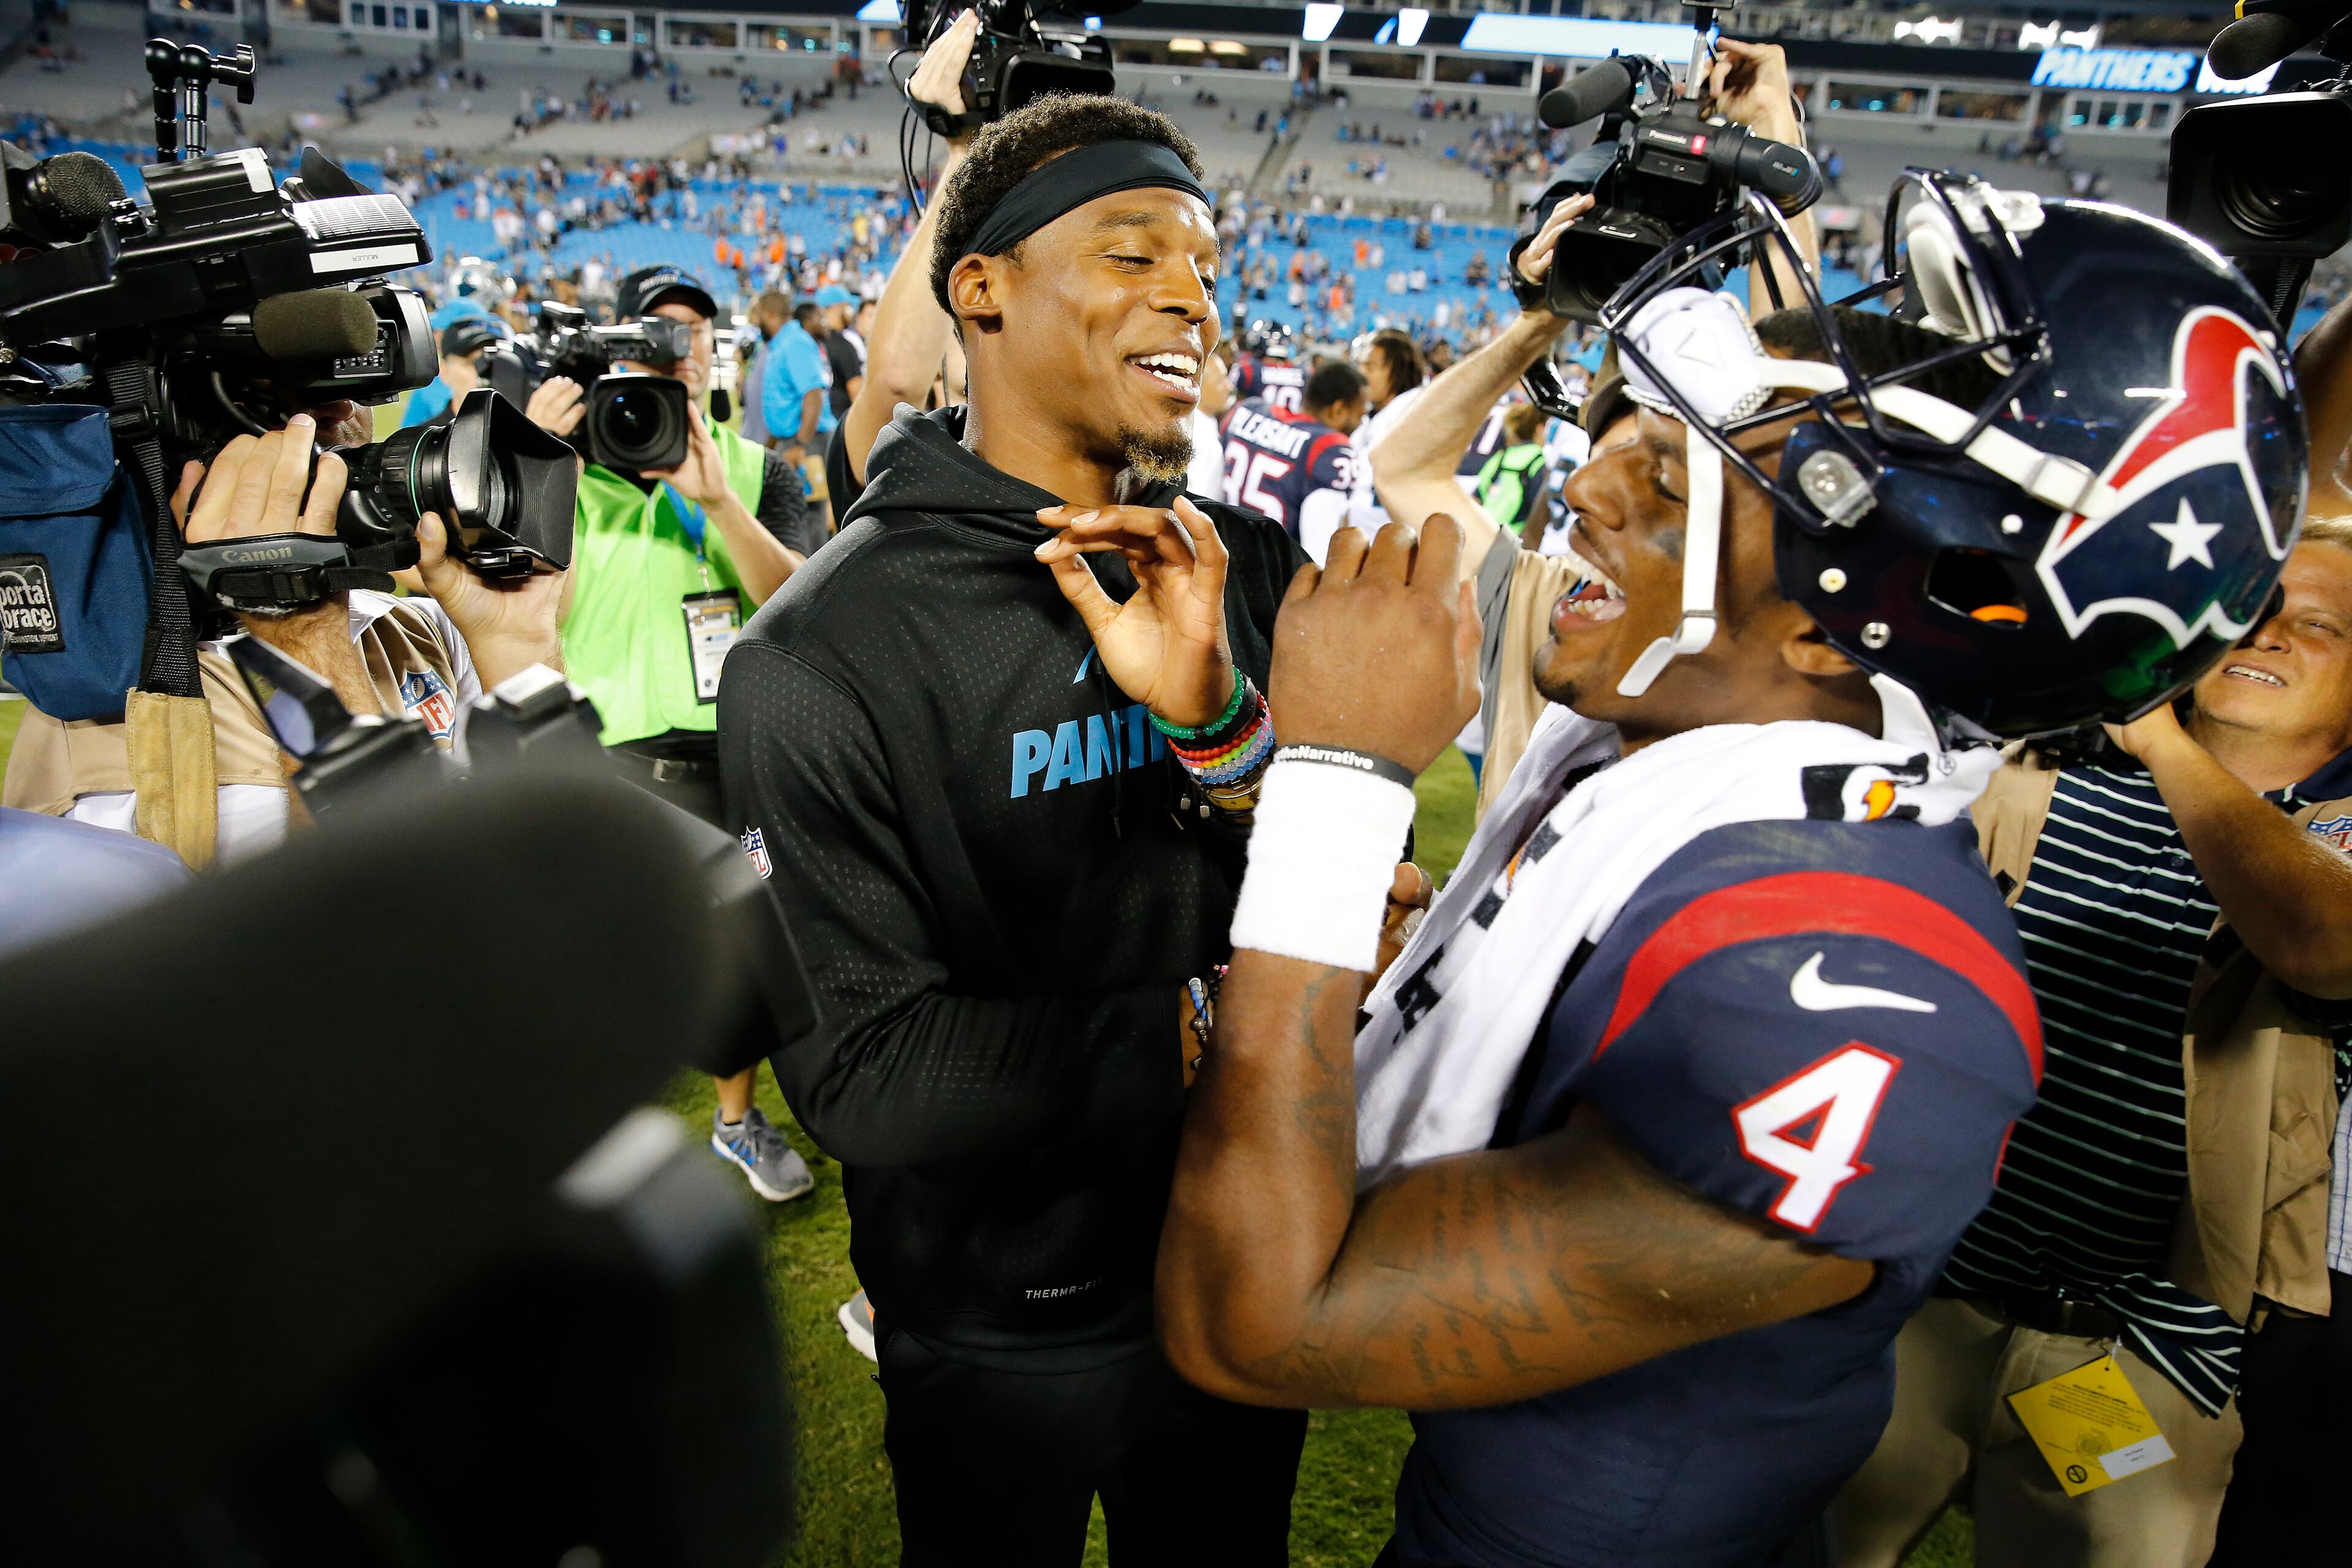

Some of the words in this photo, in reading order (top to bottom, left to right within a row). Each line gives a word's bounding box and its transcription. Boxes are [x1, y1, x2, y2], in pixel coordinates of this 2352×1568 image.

[2031, 47, 2196, 93] PANTHERS
[222, 546, 293, 562] Canon
[2, 608, 53, 629] brace
[1730, 1039, 1904, 1235] 4
